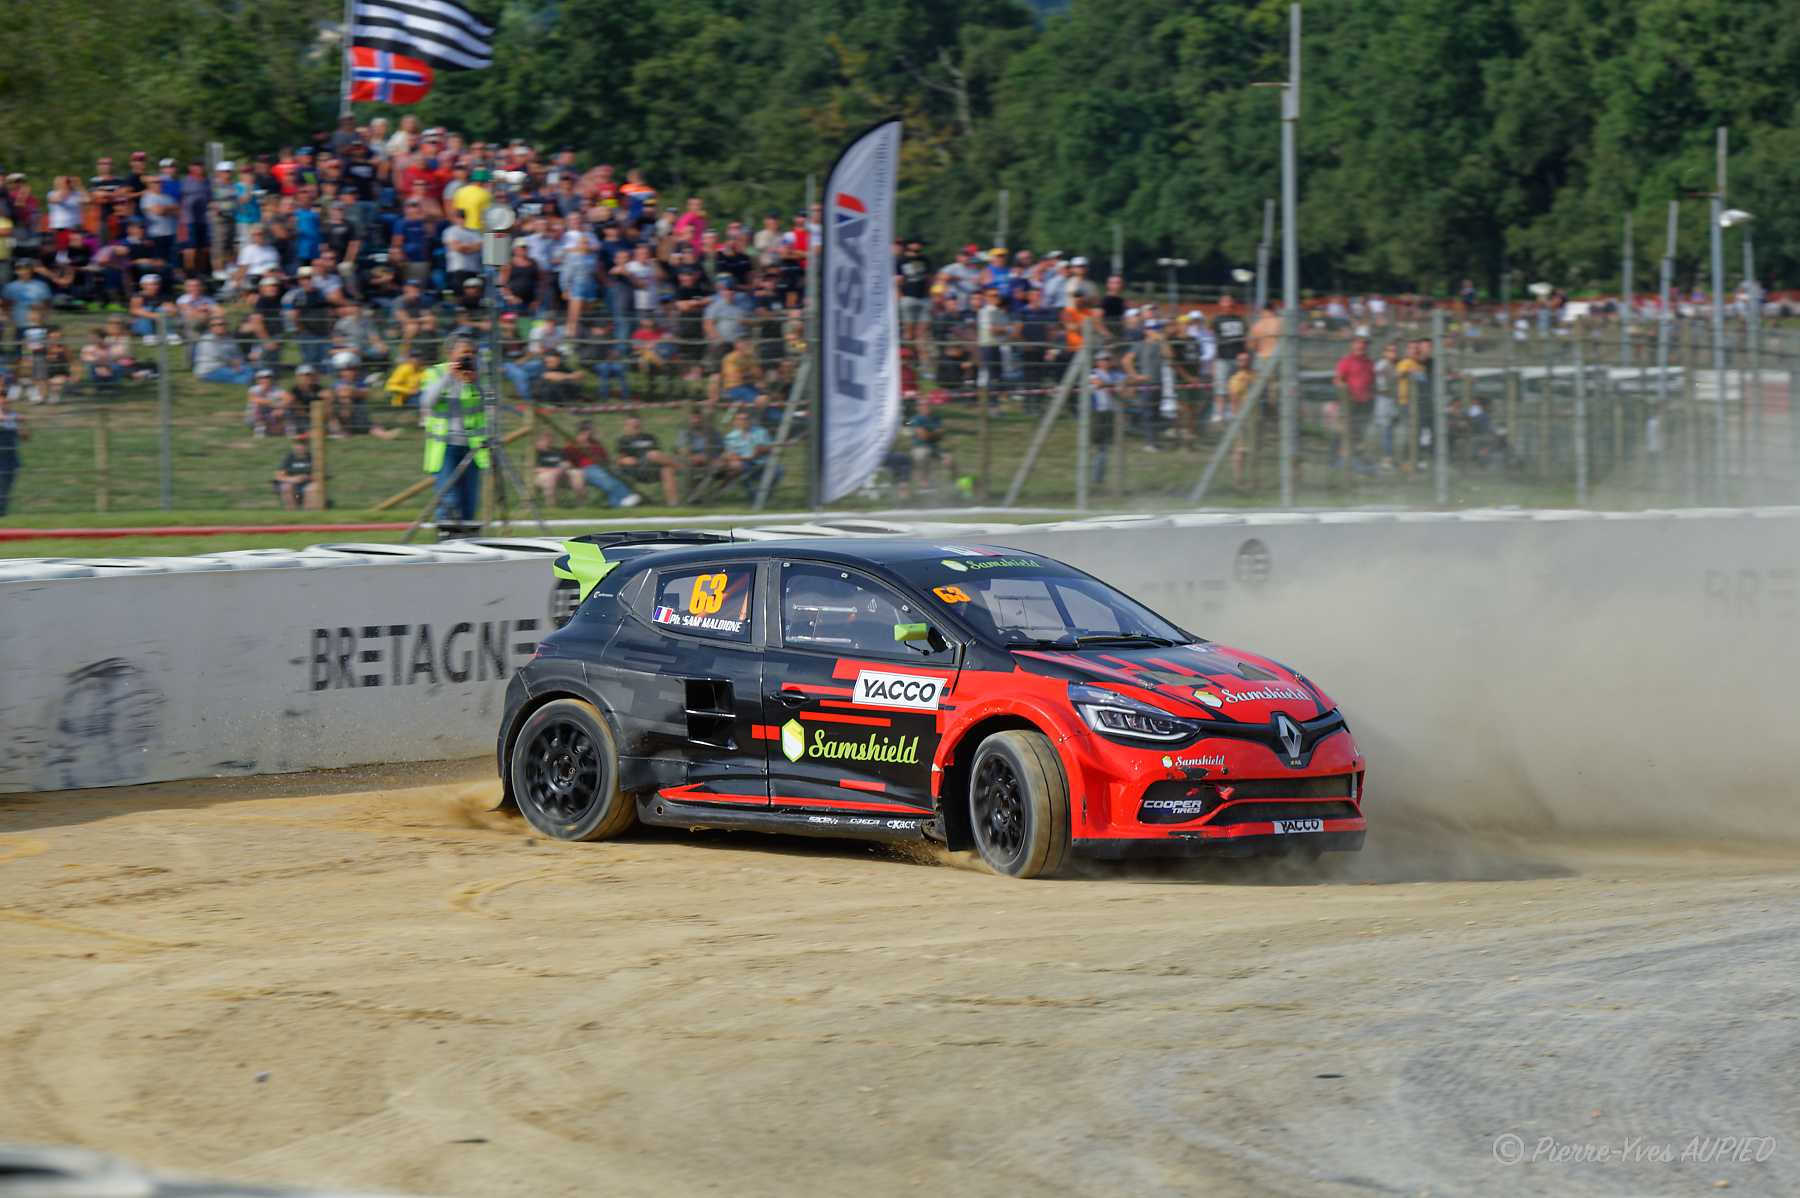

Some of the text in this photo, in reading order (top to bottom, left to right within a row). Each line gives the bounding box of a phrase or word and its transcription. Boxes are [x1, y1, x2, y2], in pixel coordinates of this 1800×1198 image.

[835, 219, 868, 400] FFSA
[688, 573, 728, 615] 63
[932, 585, 972, 604] 63
[310, 619, 538, 691] BRETAGNE
[863, 678, 936, 702] YACCO
[1221, 686, 1313, 704] Samshield
[808, 729, 920, 764] Samshield
[1175, 755, 1225, 767] Samshield
[1143, 800, 1202, 809] COOPER
[1280, 819, 1320, 831] YACCO
